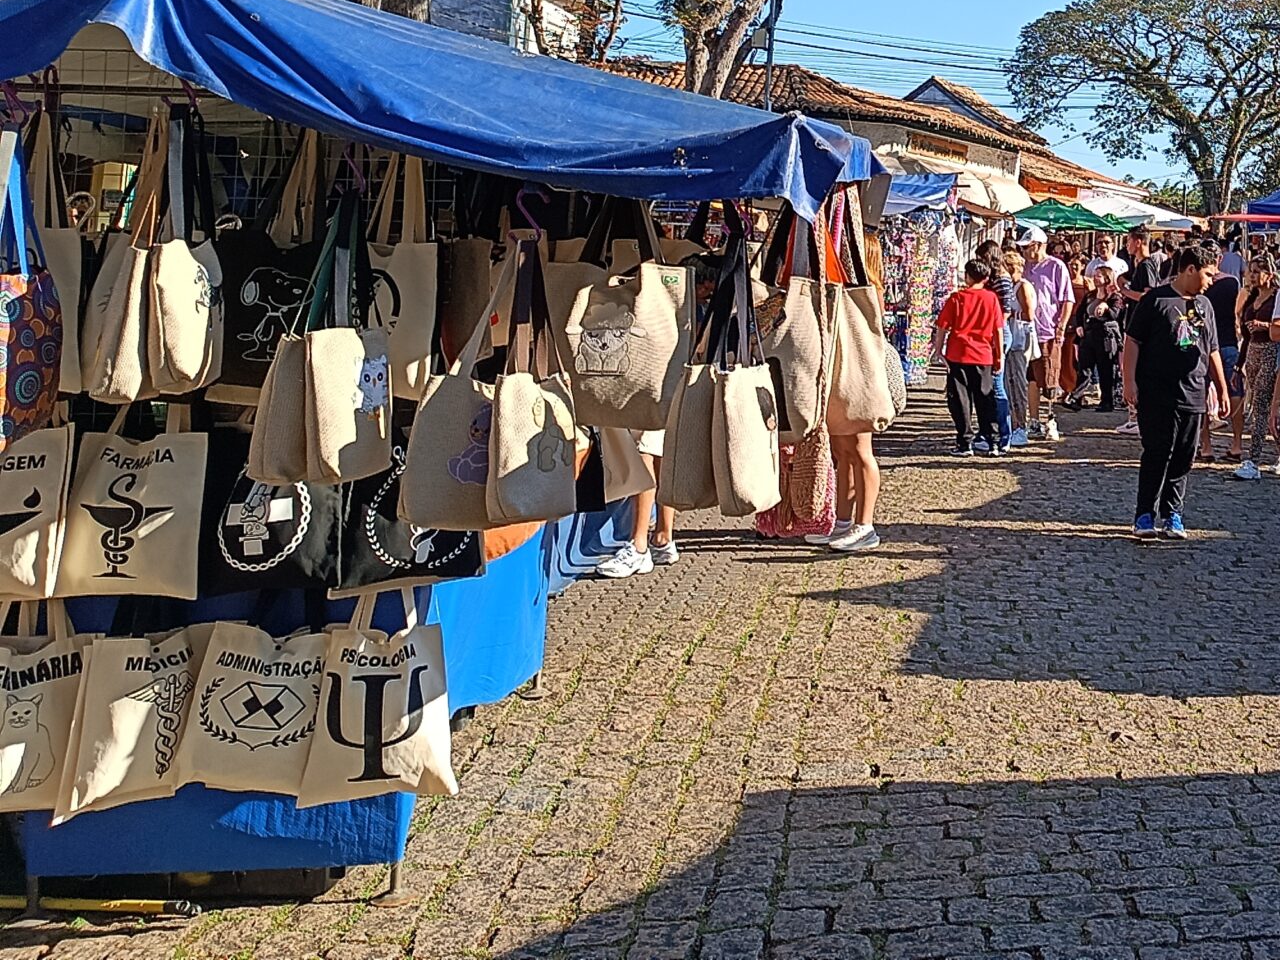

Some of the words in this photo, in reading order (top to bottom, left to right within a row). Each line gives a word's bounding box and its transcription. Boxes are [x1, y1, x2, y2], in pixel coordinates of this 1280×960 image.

[0, 454, 47, 471] GEM
[216, 651, 326, 680] ADMINISTRAÇÃ
[341, 643, 417, 668] PSICOLOGIA
